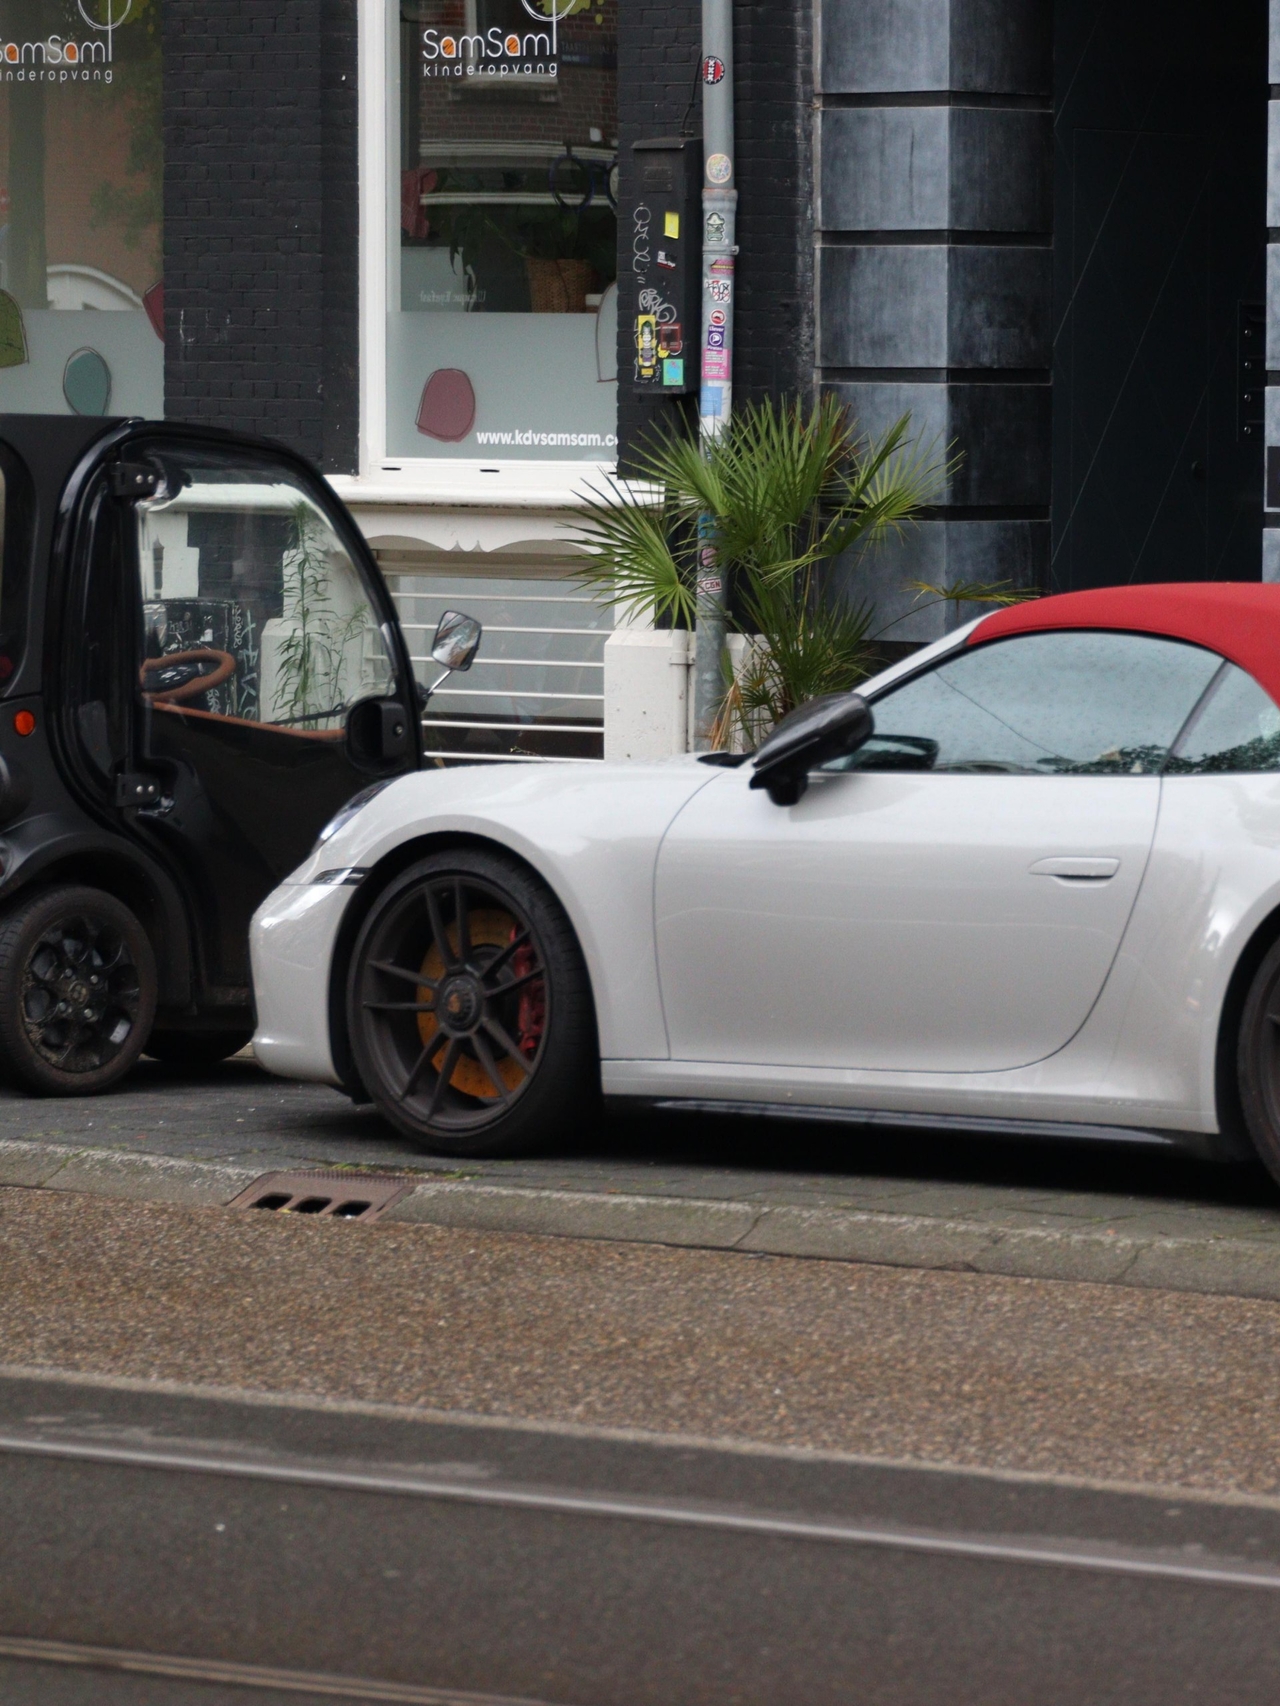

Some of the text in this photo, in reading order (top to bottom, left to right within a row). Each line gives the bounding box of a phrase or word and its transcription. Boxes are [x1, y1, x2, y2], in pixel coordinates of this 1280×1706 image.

[0, 34, 107, 65] amSam
[422, 26, 551, 60] SamSam
[0, 68, 113, 84] inderopvang
[422, 62, 558, 78] kinderopvang
